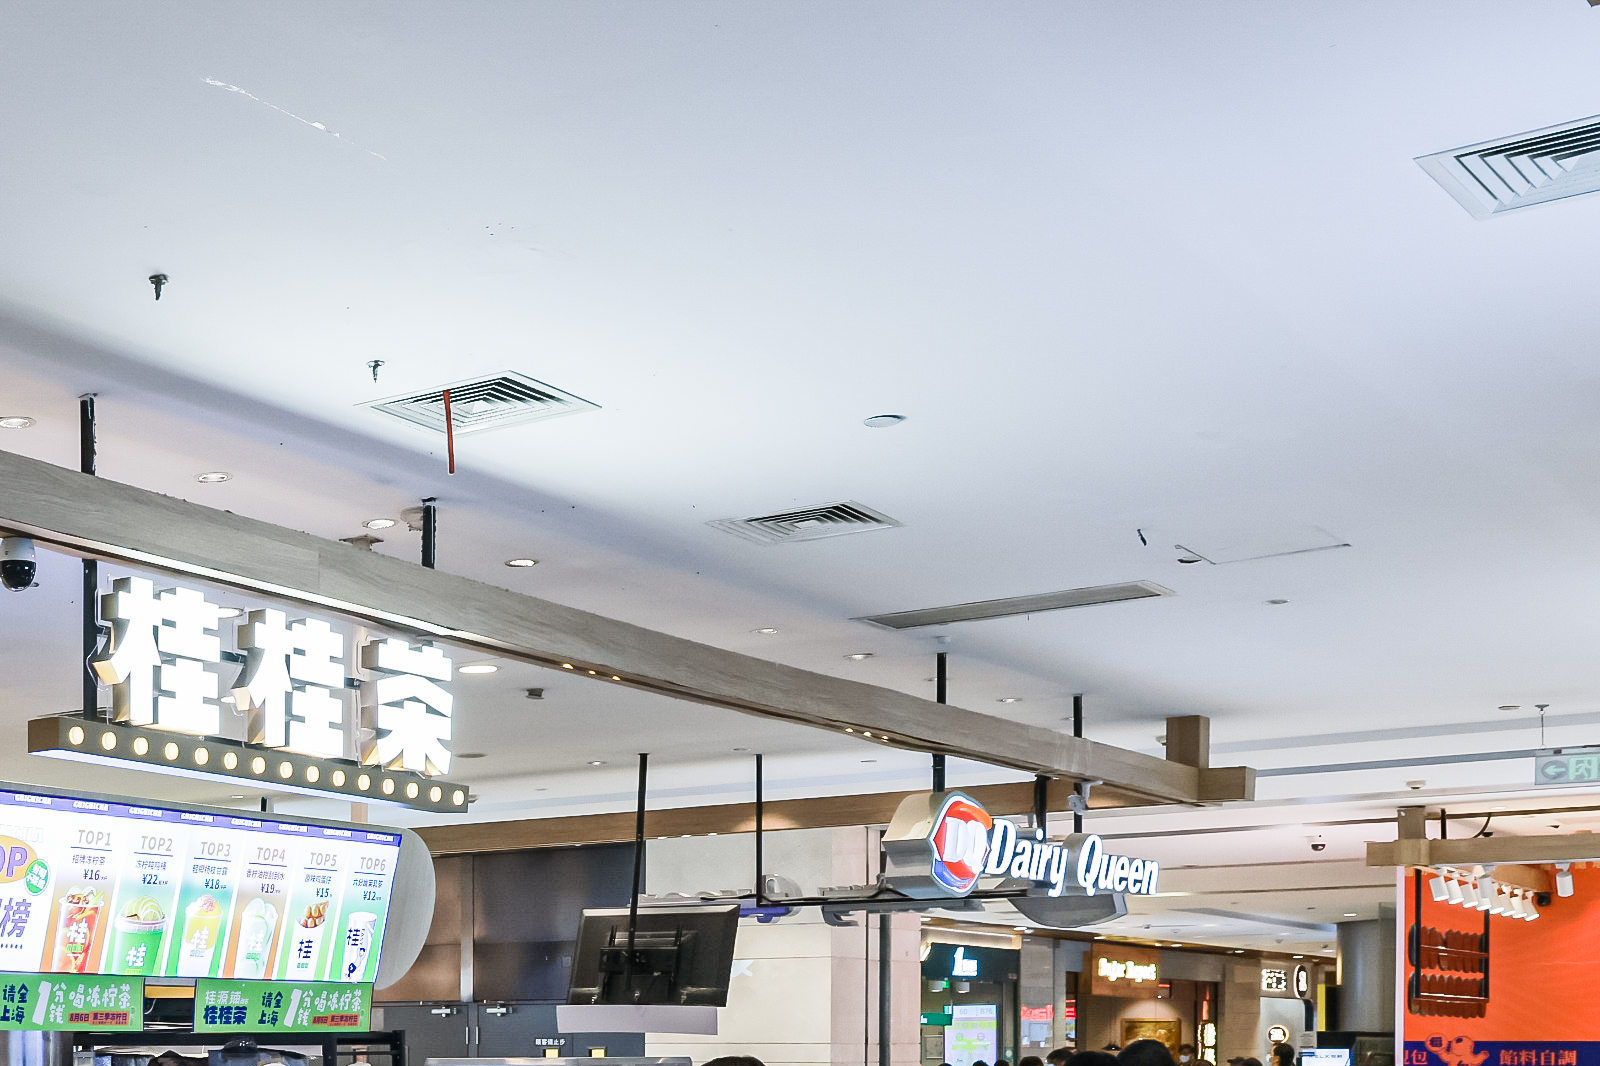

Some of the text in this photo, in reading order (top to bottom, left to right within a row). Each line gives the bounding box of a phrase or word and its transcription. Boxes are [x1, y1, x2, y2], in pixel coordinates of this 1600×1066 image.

[104, 576, 454, 776] 桂桂茶
[78, 829, 111, 846] TOP1
[141, 836, 173, 851] TOP2
[942, 816, 987, 874] DQ
[201, 841, 231, 857] TOP3
[257, 847, 286, 862] TOP4
[985, 817, 1160, 898] Dairy Queen
[311, 852, 337, 867] TOP5
[360, 857, 386, 872] TOP6
[67, 918, 88, 943] 桂
[347, 928, 361, 947] 桂
[126, 942, 147, 967] 桂
[298, 939, 313, 959] 桂
[2, 983, 29, 1004] 请全
[68, 983, 132, 1009] 喝冻柠茶
[205, 991, 242, 1005] 桂源铺
[261, 991, 284, 1009] 请全
[314, 988, 362, 1013] 喝冻柠茶
[0, 1005, 25, 1024] 上海
[69, 1012, 90, 1023] 8月6日
[203, 1006, 248, 1025] 桂桂茶
[258, 1010, 279, 1027] 上海
